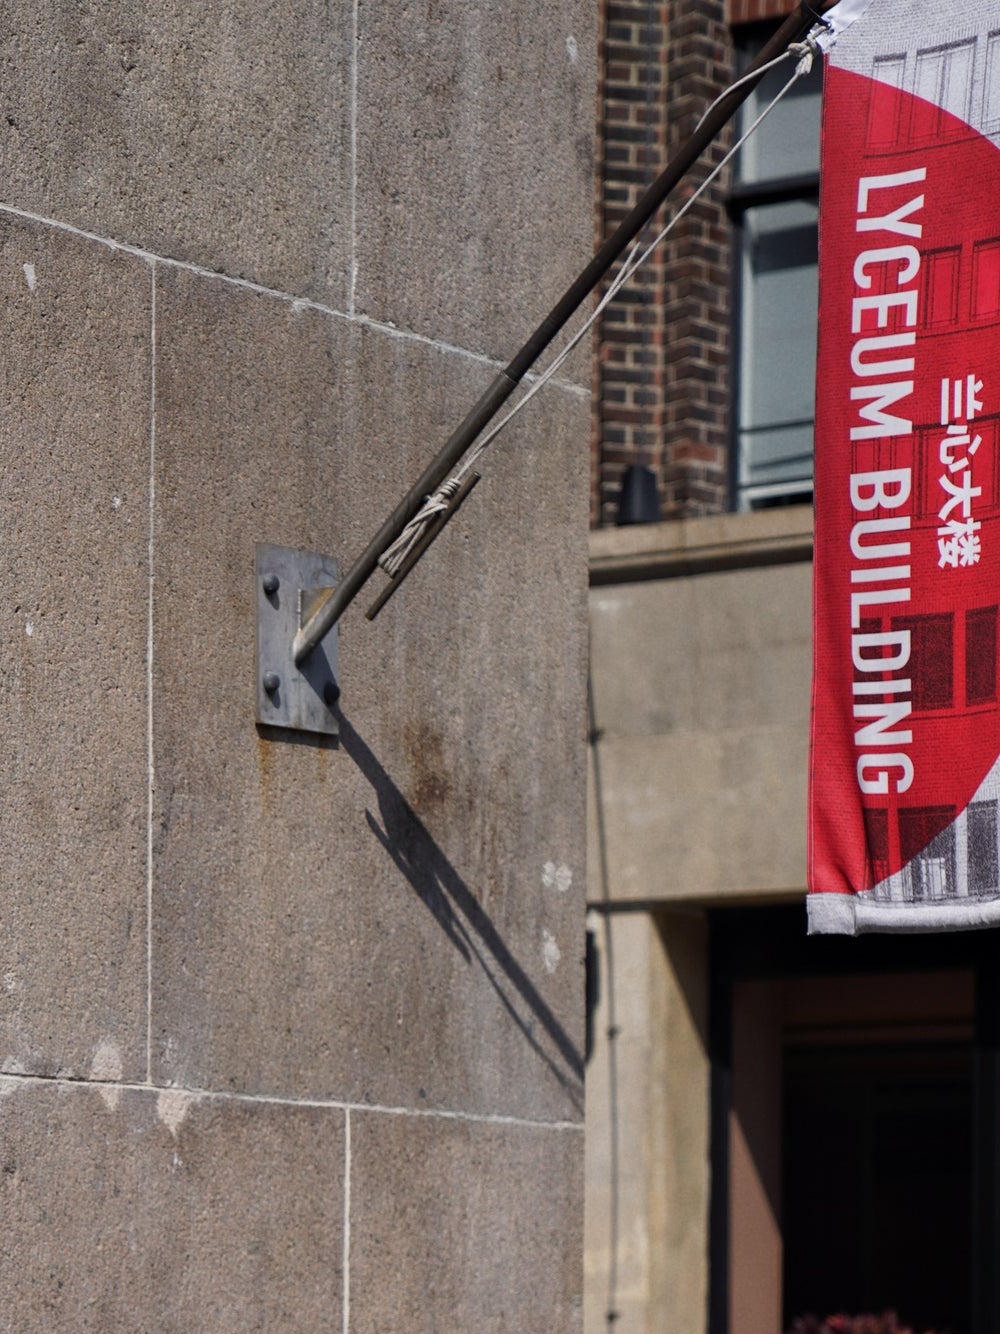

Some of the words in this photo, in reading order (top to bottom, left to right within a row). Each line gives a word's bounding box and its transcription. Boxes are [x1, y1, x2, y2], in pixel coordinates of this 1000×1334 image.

[850, 167, 927, 441] LYCEUM
[937, 373, 983, 568] 兰心大楼
[849, 467, 914, 794] BUILDING
